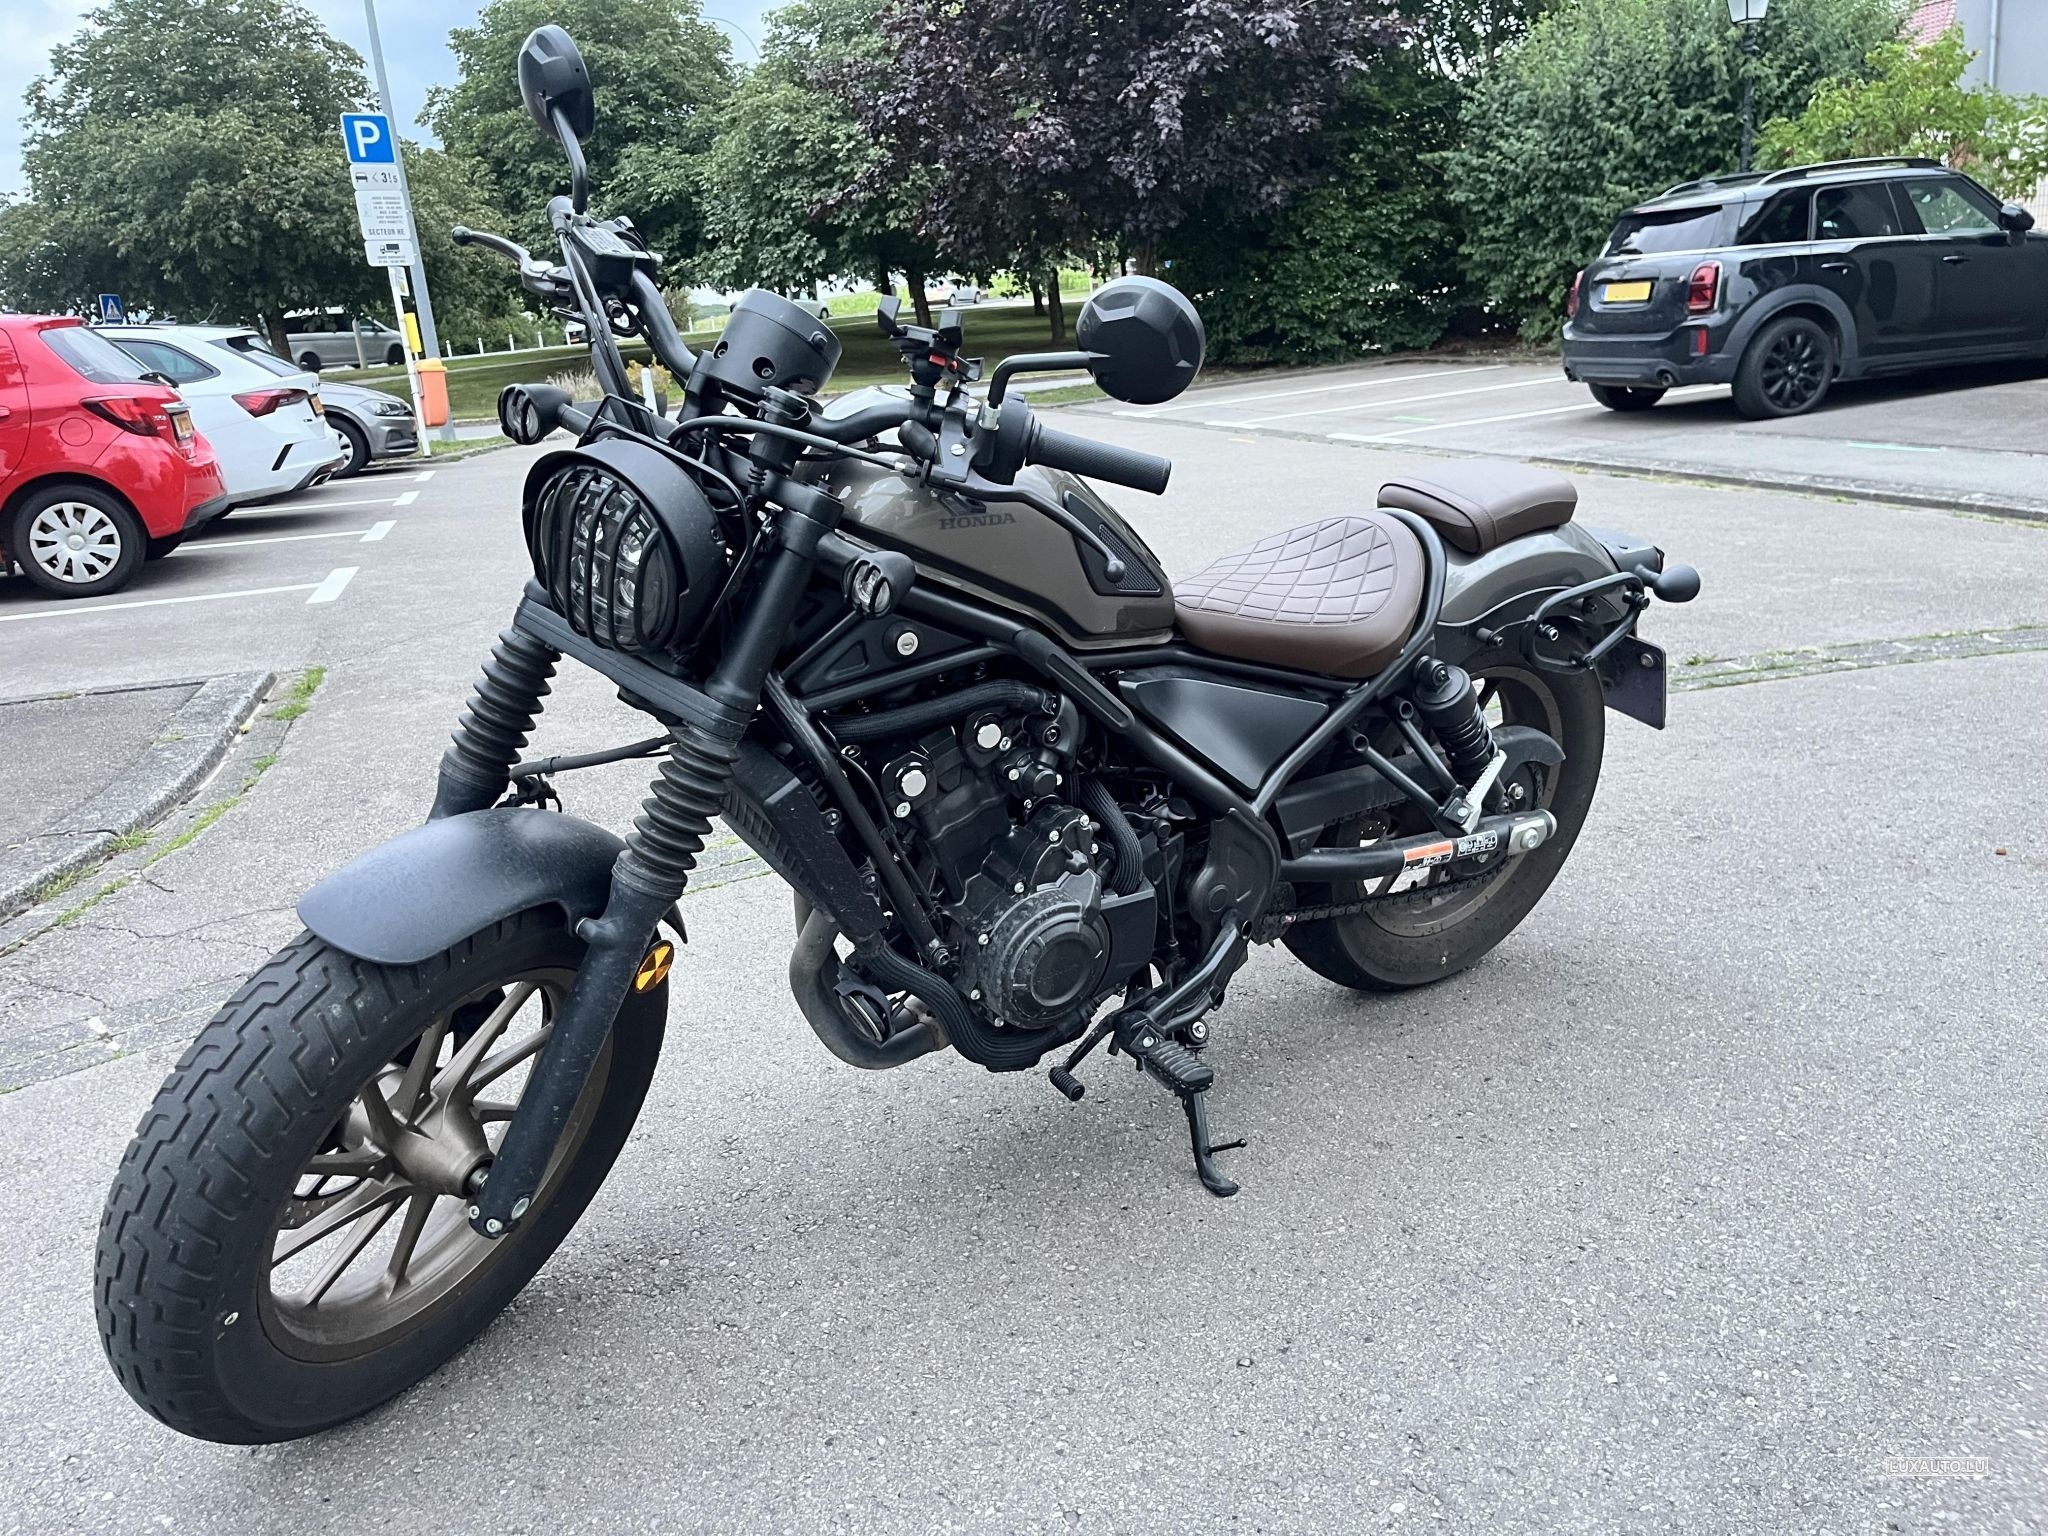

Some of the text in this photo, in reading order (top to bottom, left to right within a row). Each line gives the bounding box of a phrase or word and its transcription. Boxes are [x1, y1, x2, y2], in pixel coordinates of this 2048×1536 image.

[353, 120, 381, 158] P
[368, 228, 396, 236] SECTEUR
[938, 513, 1016, 530] HONDA
